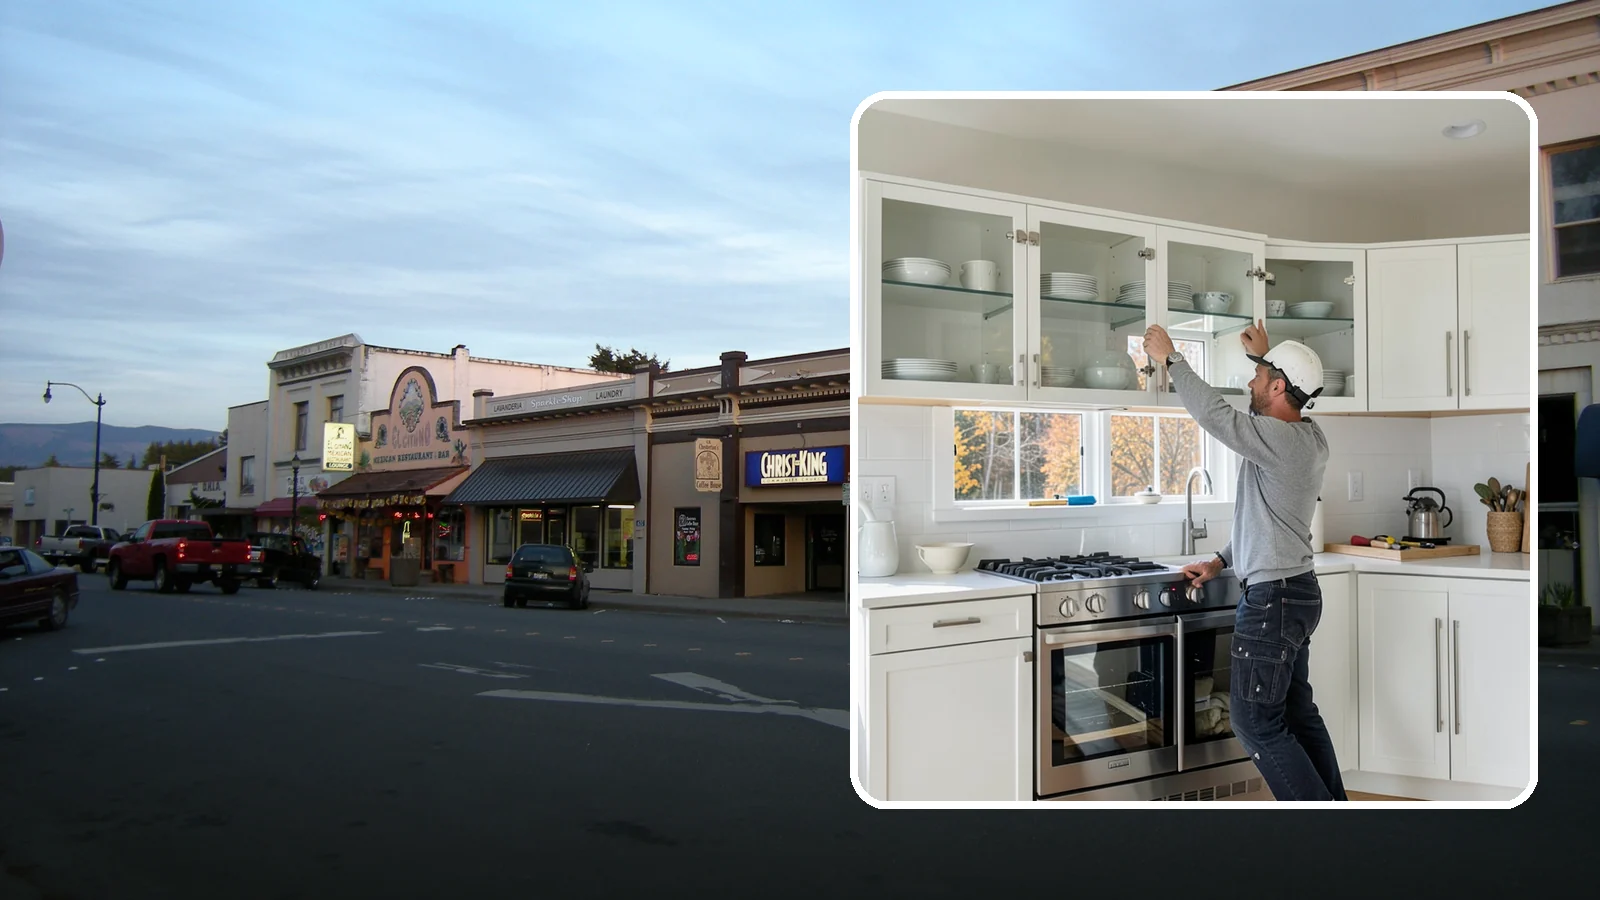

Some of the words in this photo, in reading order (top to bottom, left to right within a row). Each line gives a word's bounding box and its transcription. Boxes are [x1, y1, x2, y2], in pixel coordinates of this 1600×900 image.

[562, 394, 582, 405] Shop
[595, 389, 624, 400] LAUNDRY
[493, 402, 523, 412] LAVANDERIA
[373, 455, 396, 464] MEXICAN
[397, 452, 434, 462] RESTAURANT
[438, 450, 450, 459] BAR
[761, 452, 797, 477] CHRIST
[799, 450, 827, 476] KING
